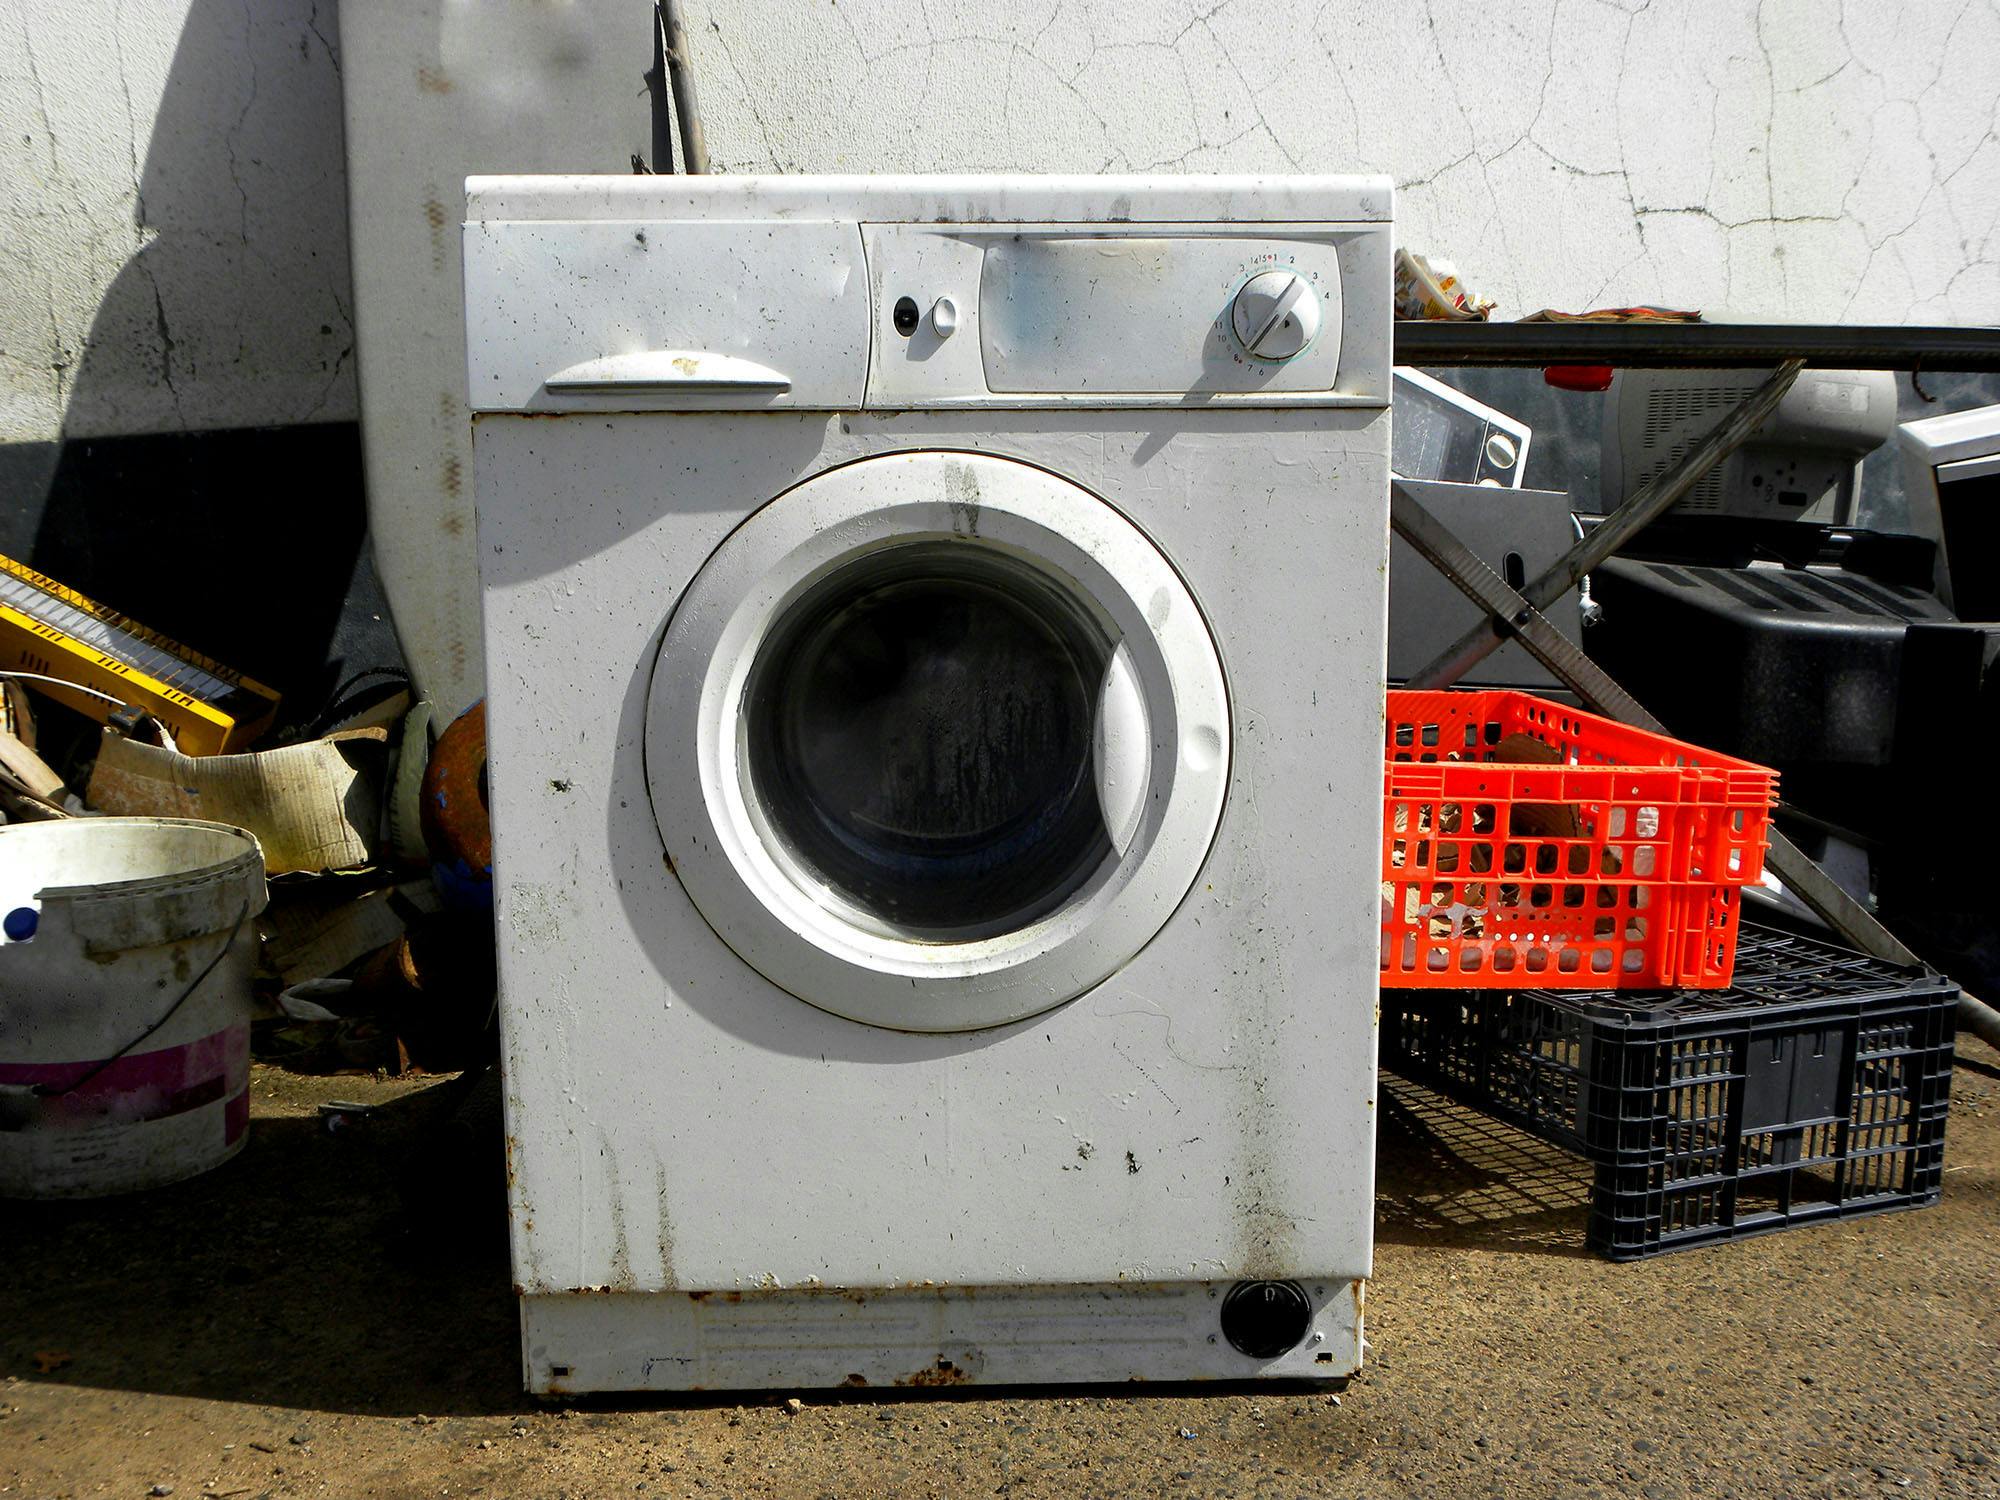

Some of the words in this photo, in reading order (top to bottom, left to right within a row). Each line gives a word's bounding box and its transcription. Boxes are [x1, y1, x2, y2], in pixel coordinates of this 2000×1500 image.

[1250, 256, 1258, 264] 14
[1258, 254, 1267, 262] 15
[1273, 253, 1278, 261] 1
[1289, 256, 1295, 264] 2
[1312, 272, 1318, 280] 3
[1324, 291, 1330, 300] 4
[1215, 321, 1223, 329] 11
[1218, 334, 1227, 342] 10
[1233, 353, 1239, 361] 8
[1247, 364, 1253, 372] 7
[1258, 367, 1264, 376] 6
